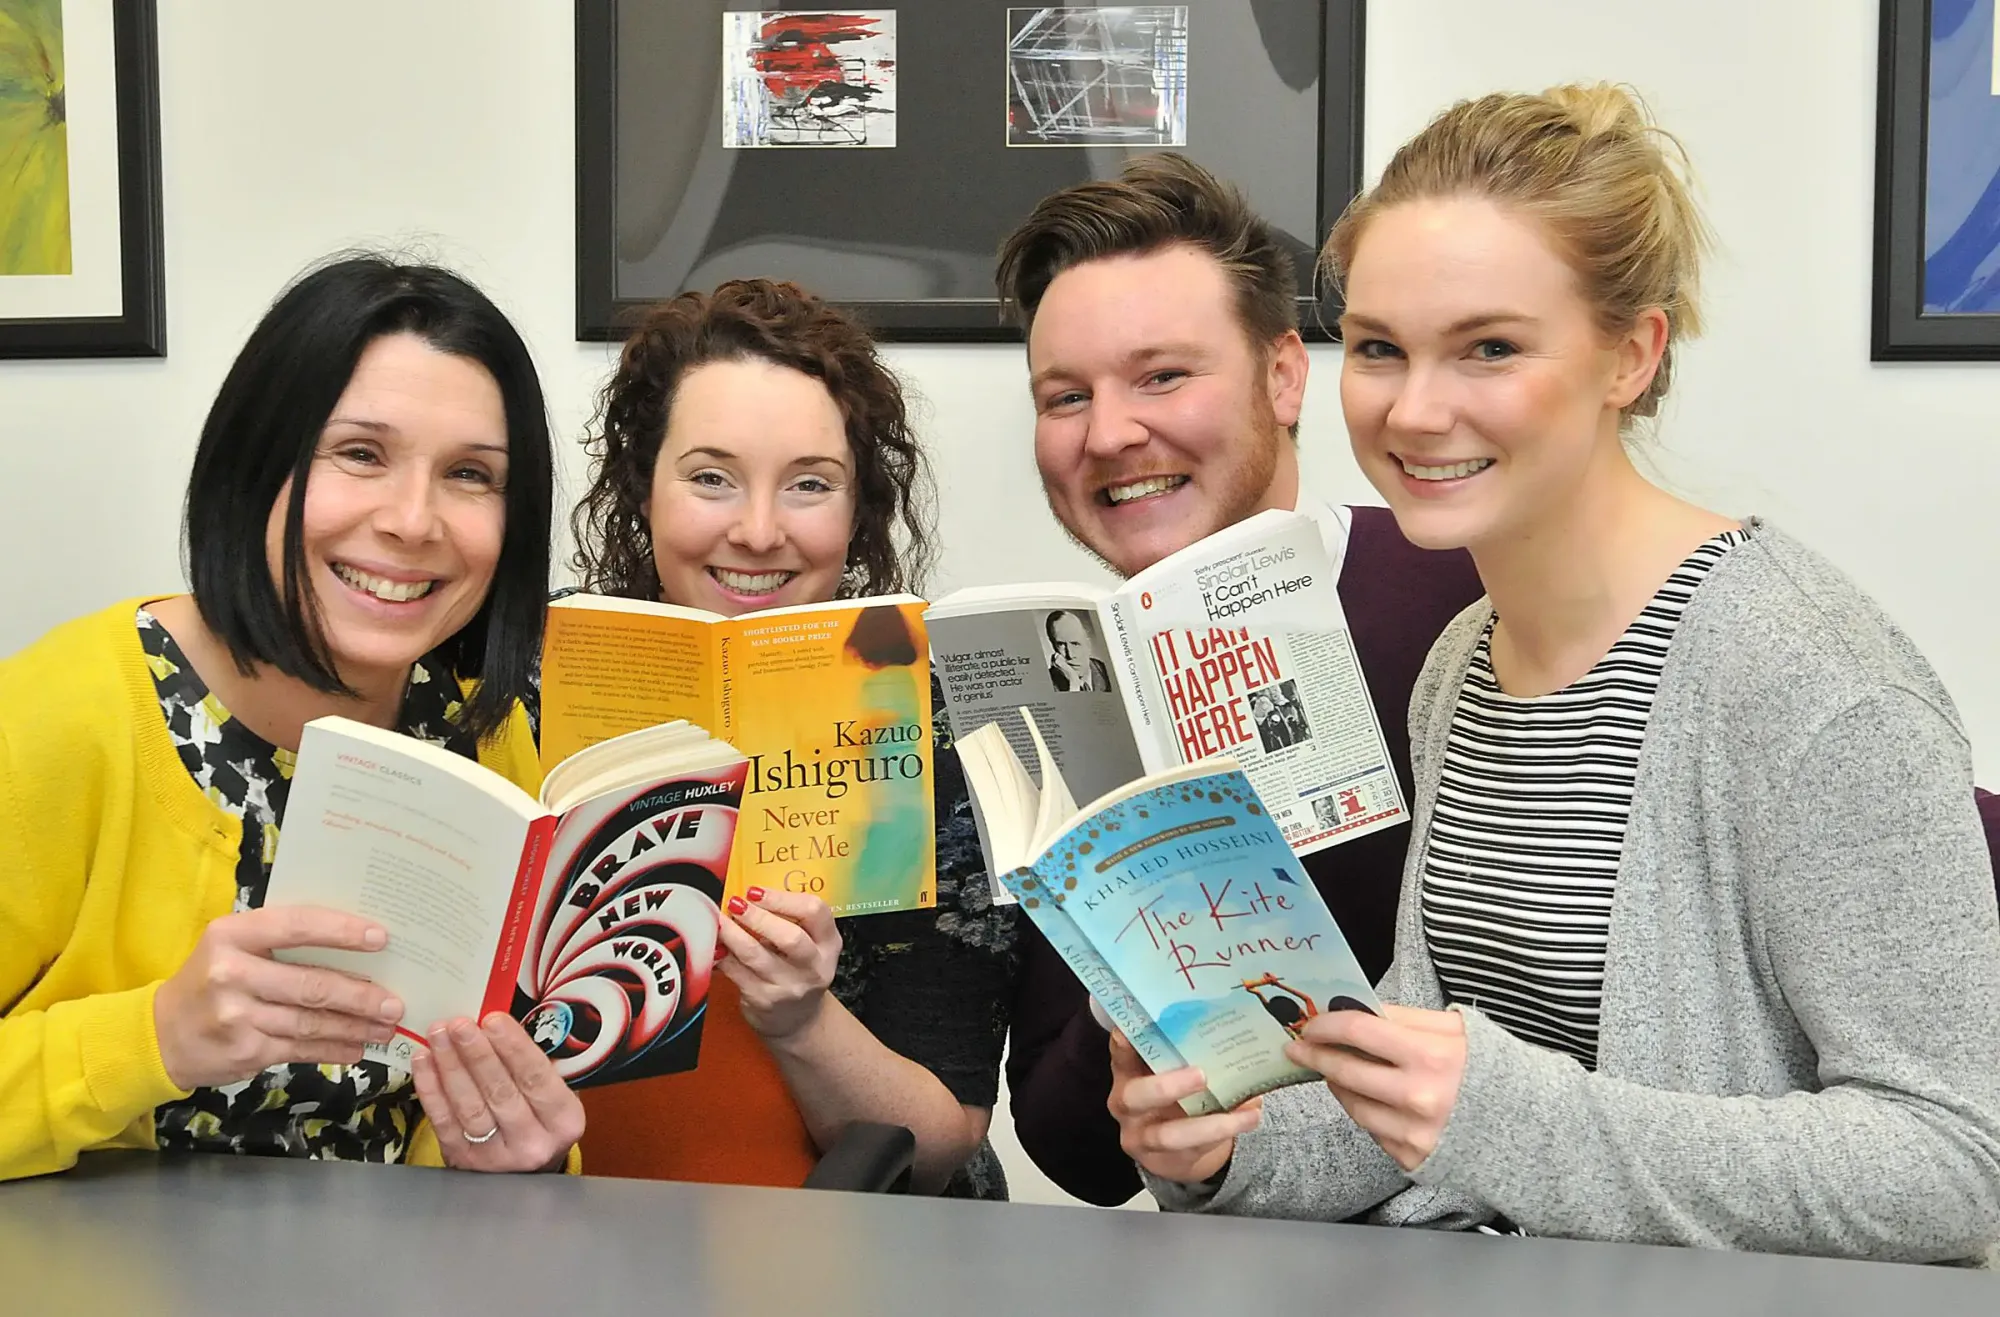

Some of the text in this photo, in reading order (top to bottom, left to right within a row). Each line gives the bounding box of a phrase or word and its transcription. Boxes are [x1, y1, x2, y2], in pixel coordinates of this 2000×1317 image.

[1197, 560, 1249, 591] Sinclair
[1252, 546, 1296, 571] Lewis
[1202, 574, 1260, 608] It Can't
[1207, 590, 1274, 622] Happen
[1274, 575, 1314, 598] Here
[743, 620, 840, 637] SHORTLISTED FOR THE
[751, 632, 832, 647] MAN BOOKER PRIZE
[1111, 602, 1124, 632] Sinclair
[1120, 632, 1132, 657] Lewis
[722, 637, 731, 676] Kazuo
[974, 648, 1004, 659] almost
[990, 656, 1016, 668] public
[1152, 629, 1180, 676] IT
[948, 674, 972, 682] easily
[974, 668, 1016, 680] detected
[950, 684, 964, 692] He
[964, 682, 984, 690] was
[1000, 678, 1022, 686] actor
[1164, 637, 1281, 720] HAPPEN
[721, 678, 732, 728] Ishiguro
[954, 694, 962, 702] of
[833, 720, 923, 748] Kazuo
[1178, 697, 1254, 763] HERE
[336, 752, 377, 770] VINTAGE
[379, 766, 422, 786] CLASSICS
[748, 748, 923, 799] Ishiguro
[629, 780, 736, 812] VINTAGE HUXLEY
[1340, 796, 1366, 817] 1
[762, 806, 840, 832] Never
[568, 810, 704, 910] BRAVE
[755, 834, 850, 865] Let Me
[783, 869, 825, 893] Go
[1084, 854, 1169, 912] KHALED
[1176, 830, 1275, 861] HOSSEINI
[598, 889, 674, 932] NEW
[846, 900, 900, 911] BESTSELLER
[1114, 878, 1294, 950] The Kite
[612, 940, 676, 996] WORLD
[1168, 933, 1322, 990] Runner
[1063, 944, 1110, 998] KHALED
[1108, 1000, 1161, 1061] HOSSEINI
